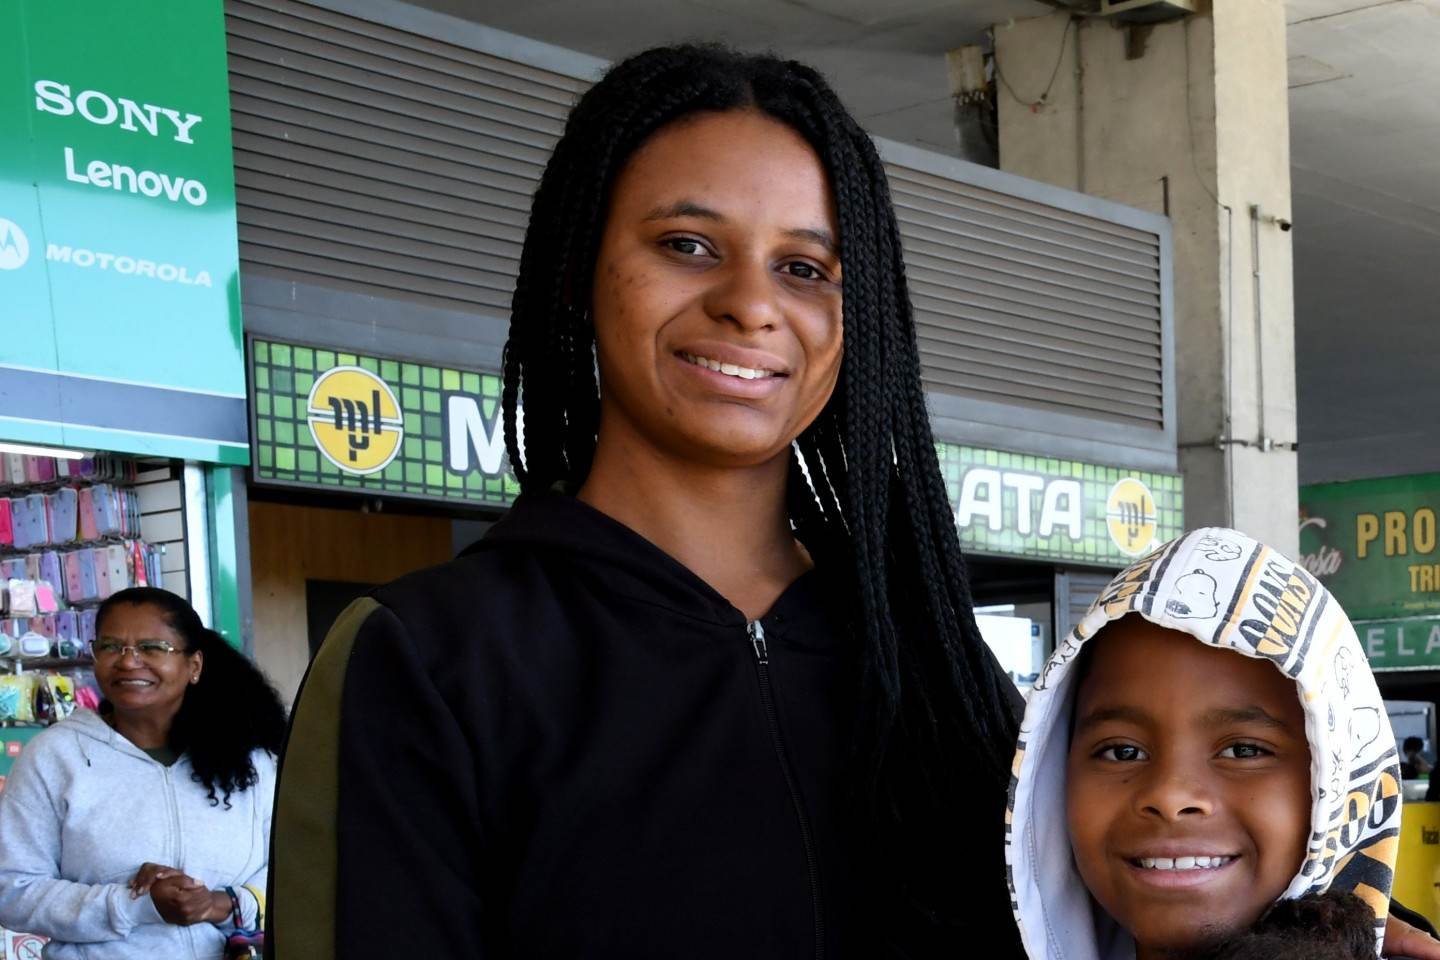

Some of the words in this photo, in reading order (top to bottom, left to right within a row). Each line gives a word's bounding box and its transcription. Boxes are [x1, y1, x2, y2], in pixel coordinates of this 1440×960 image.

[34, 80, 202, 145] SONY
[64, 147, 208, 206] Lenovo
[46, 243, 213, 288] MOTOROLA
[449, 396, 528, 474] M
[956, 468, 1082, 539] ATA
